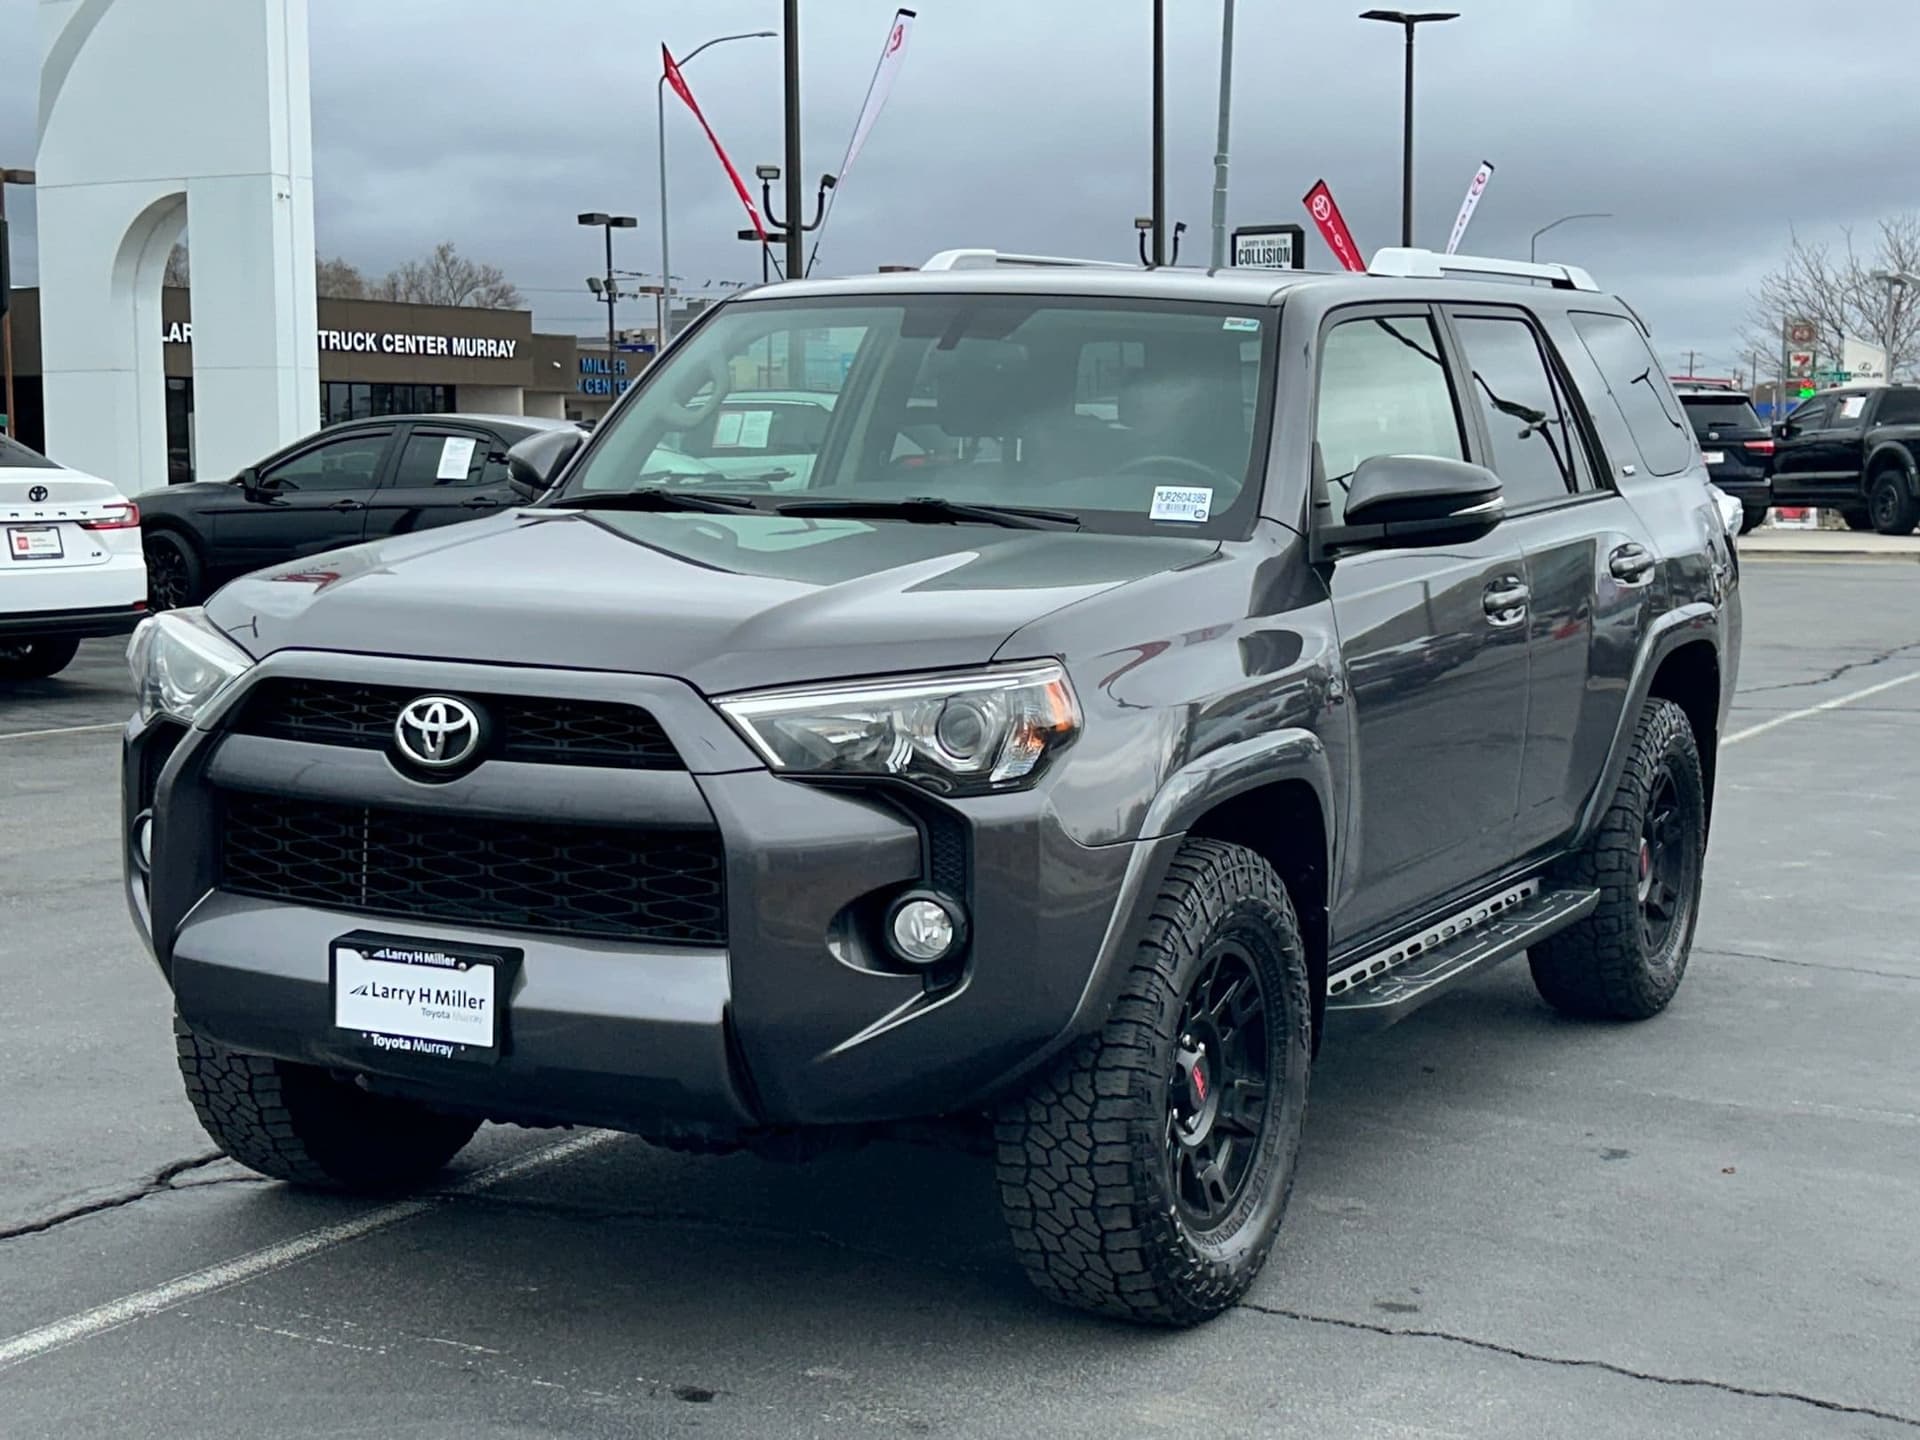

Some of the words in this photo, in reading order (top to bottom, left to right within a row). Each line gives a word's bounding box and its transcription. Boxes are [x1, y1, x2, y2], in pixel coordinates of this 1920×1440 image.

[1238, 247, 1290, 265] COLLISION
[162, 322, 192, 343] AR
[318, 330, 377, 352] TRUCK
[382, 334, 448, 355] CENTER
[452, 337, 516, 358] MURRAY
[581, 357, 627, 375] MILLR
[584, 379, 633, 395] CENE
[386, 948, 413, 965] Larry
[415, 951, 424, 962] H
[424, 952, 456, 967] Miller
[372, 982, 415, 1006] Larry
[419, 987, 431, 1003] H
[435, 989, 485, 1010] Miller
[421, 1007, 450, 1021] Toyota
[452, 1010, 483, 1024] Murray
[371, 1033, 411, 1051] Toyota
[412, 1038, 454, 1058] Murray
